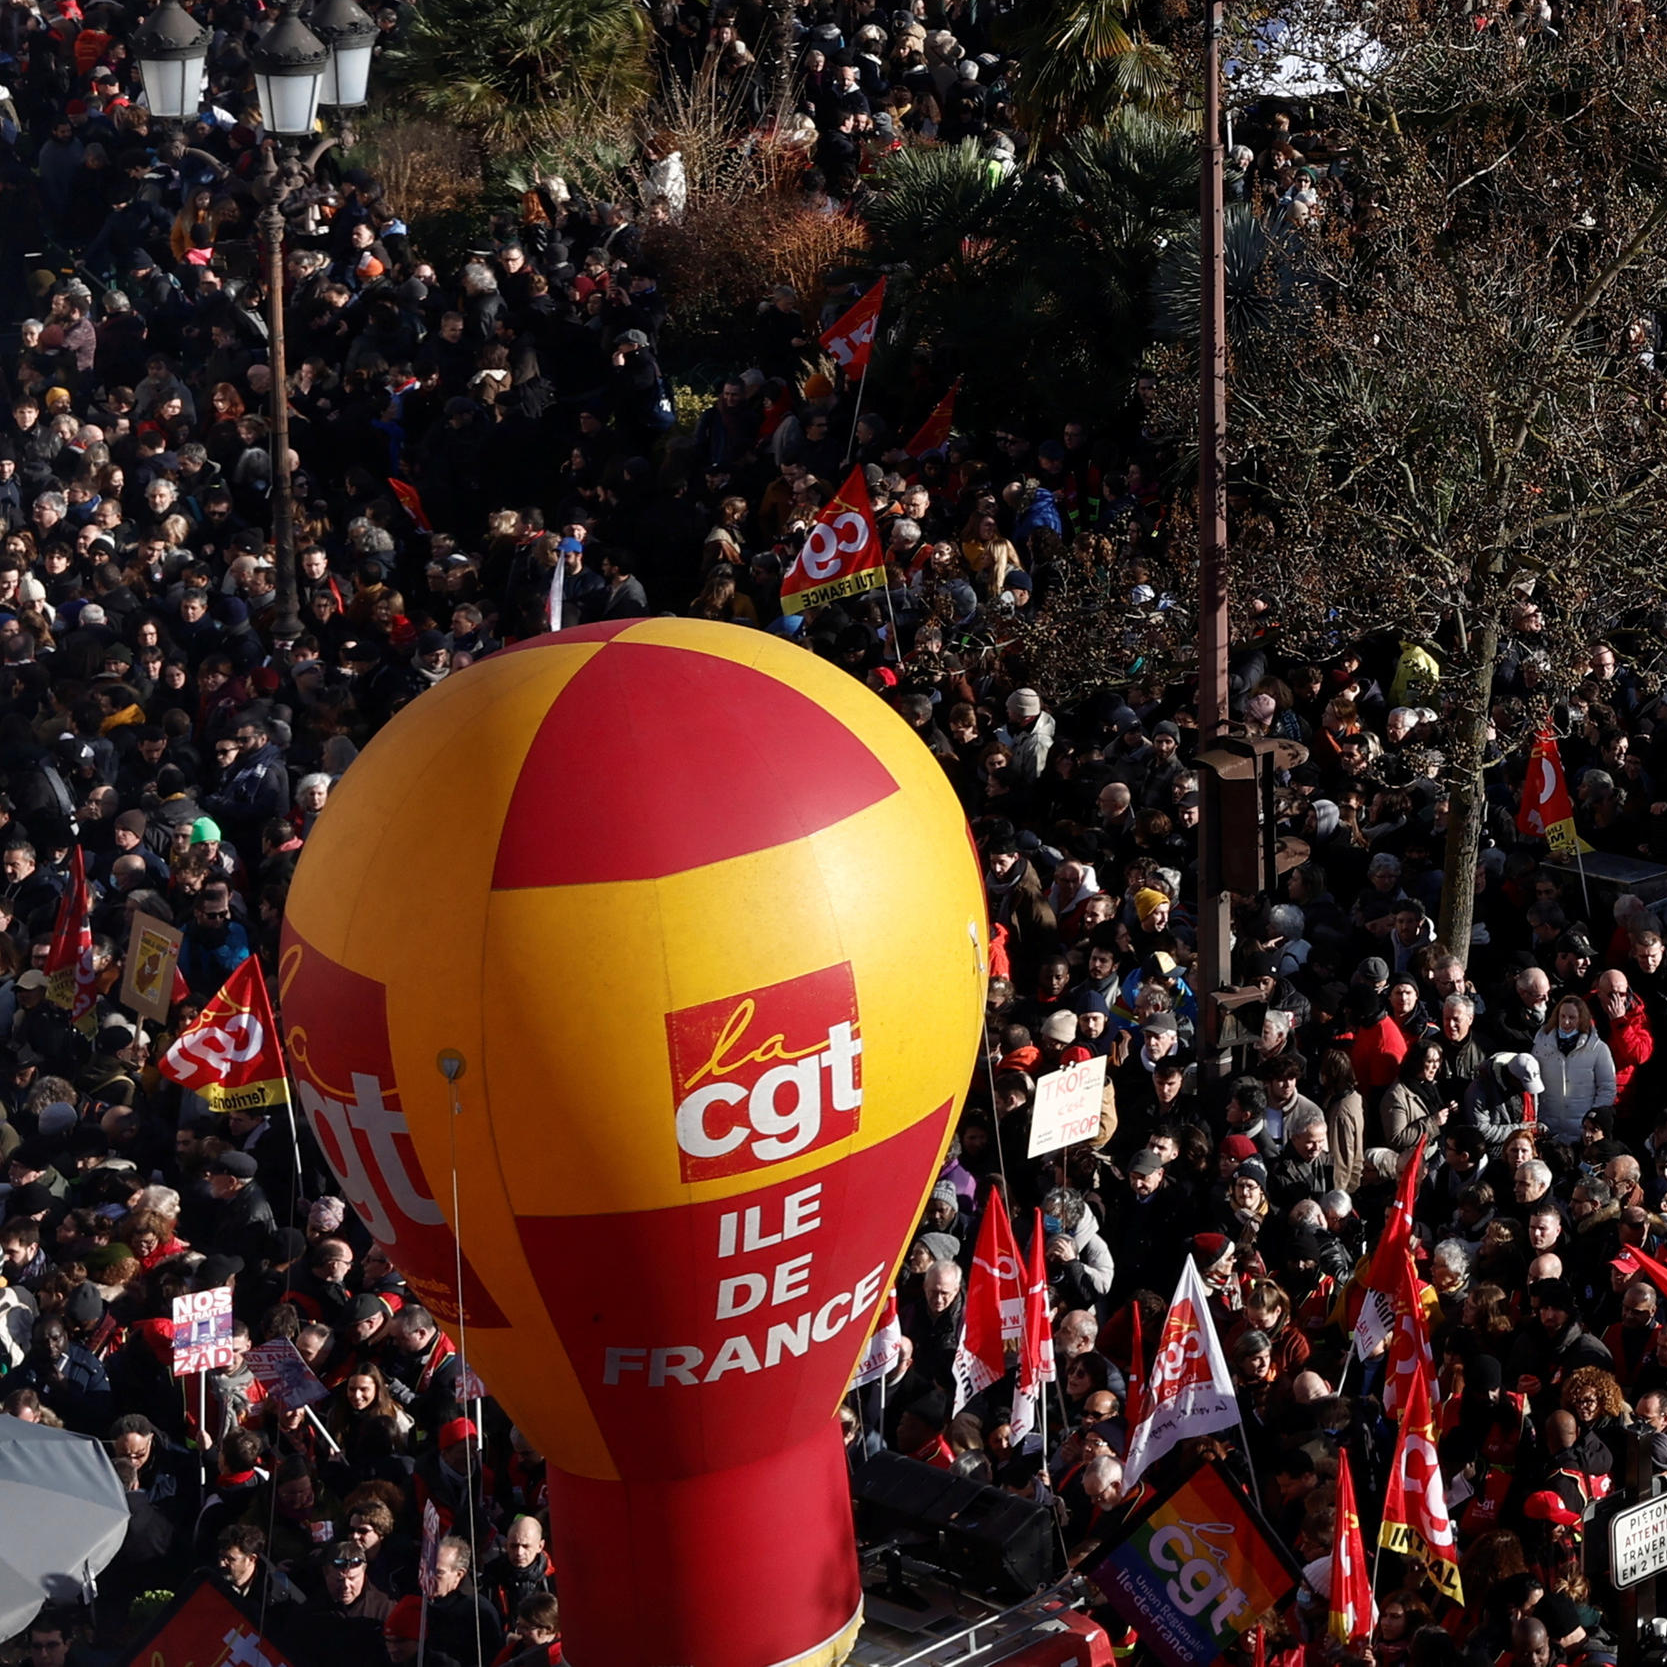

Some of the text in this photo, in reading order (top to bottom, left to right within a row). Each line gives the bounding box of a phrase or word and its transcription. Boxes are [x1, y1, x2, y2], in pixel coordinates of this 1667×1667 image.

[686, 998, 863, 1085] la
[674, 1022, 863, 1161] cgt
[1043, 1066, 1092, 1103] TROP
[292, 1072, 450, 1245] gt
[1059, 1114, 1100, 1143] TROP
[717, 1183, 822, 1259] ILE
[173, 1287, 232, 1316] NOS
[173, 1305, 233, 1324] RETRAITES
[602, 1260, 887, 1388] FRANCE
[715, 1251, 814, 1321] DE
[174, 1347, 233, 1377] ZAD
[1149, 1524, 1251, 1636] cgt
[1622, 1567, 1638, 1581] EN
[1641, 1560, 1648, 1572] 2
[1116, 1566, 1194, 1663] Île-de-France
[1135, 1574, 1205, 1653] Union Régionale
